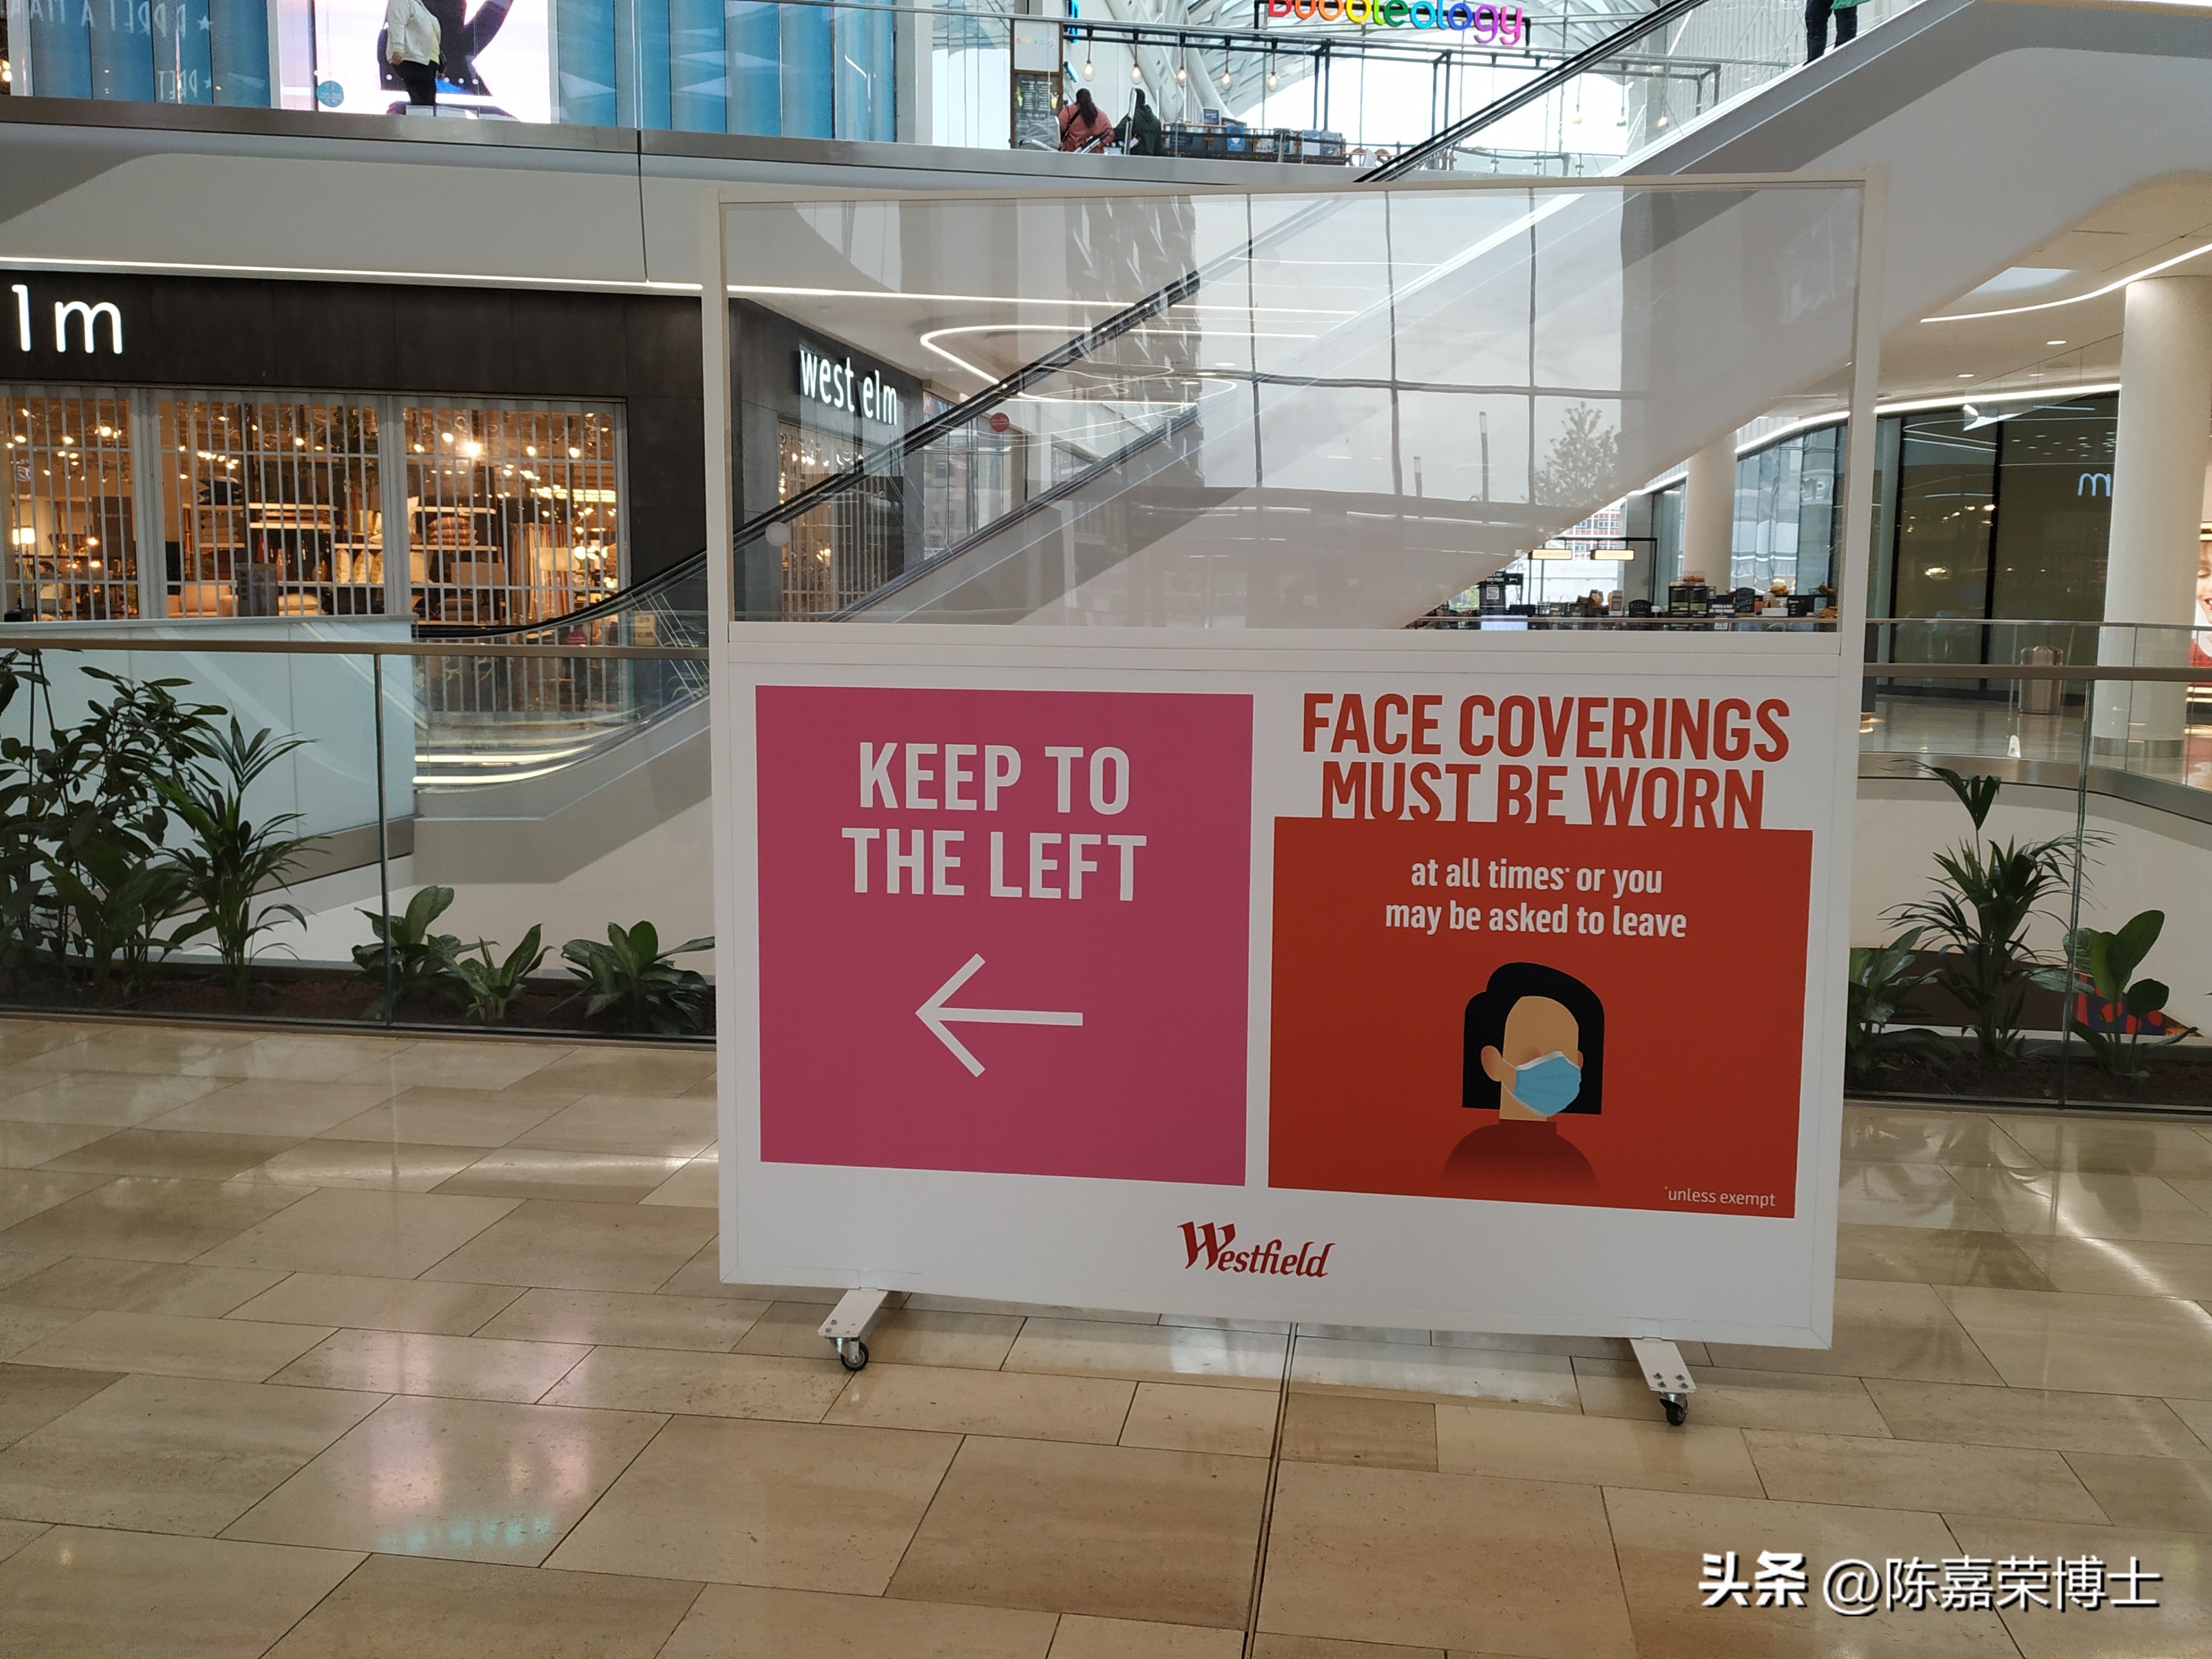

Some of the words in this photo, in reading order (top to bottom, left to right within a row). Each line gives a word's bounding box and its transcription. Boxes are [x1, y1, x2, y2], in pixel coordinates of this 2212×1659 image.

[800, 350, 855, 413] west
[863, 369, 897, 426] elm
[1302, 693, 1443, 755] FACE
[1458, 694, 1790, 763] COVERINGS
[860, 742, 1022, 811] KEEP
[1044, 745, 1129, 815] TO
[1322, 761, 1481, 823] MUST
[1497, 764, 1567, 824] BE
[1584, 766, 1765, 830] WORN
[841, 827, 965, 896] THE
[990, 831, 1147, 902] LEFT
[1411, 859, 1439, 886] at
[1446, 857, 1480, 888] all
[1576, 868, 1606, 892] or
[1613, 869, 1662, 899] you
[1386, 905, 1442, 935] may
[1449, 899, 1481, 931] be
[1488, 902, 1568, 934] asked
[1577, 906, 1604, 935] to
[1613, 905, 1687, 938] leave
[1720, 1193, 1775, 1209] exempt
[1177, 1221, 1336, 1278] Westfield
